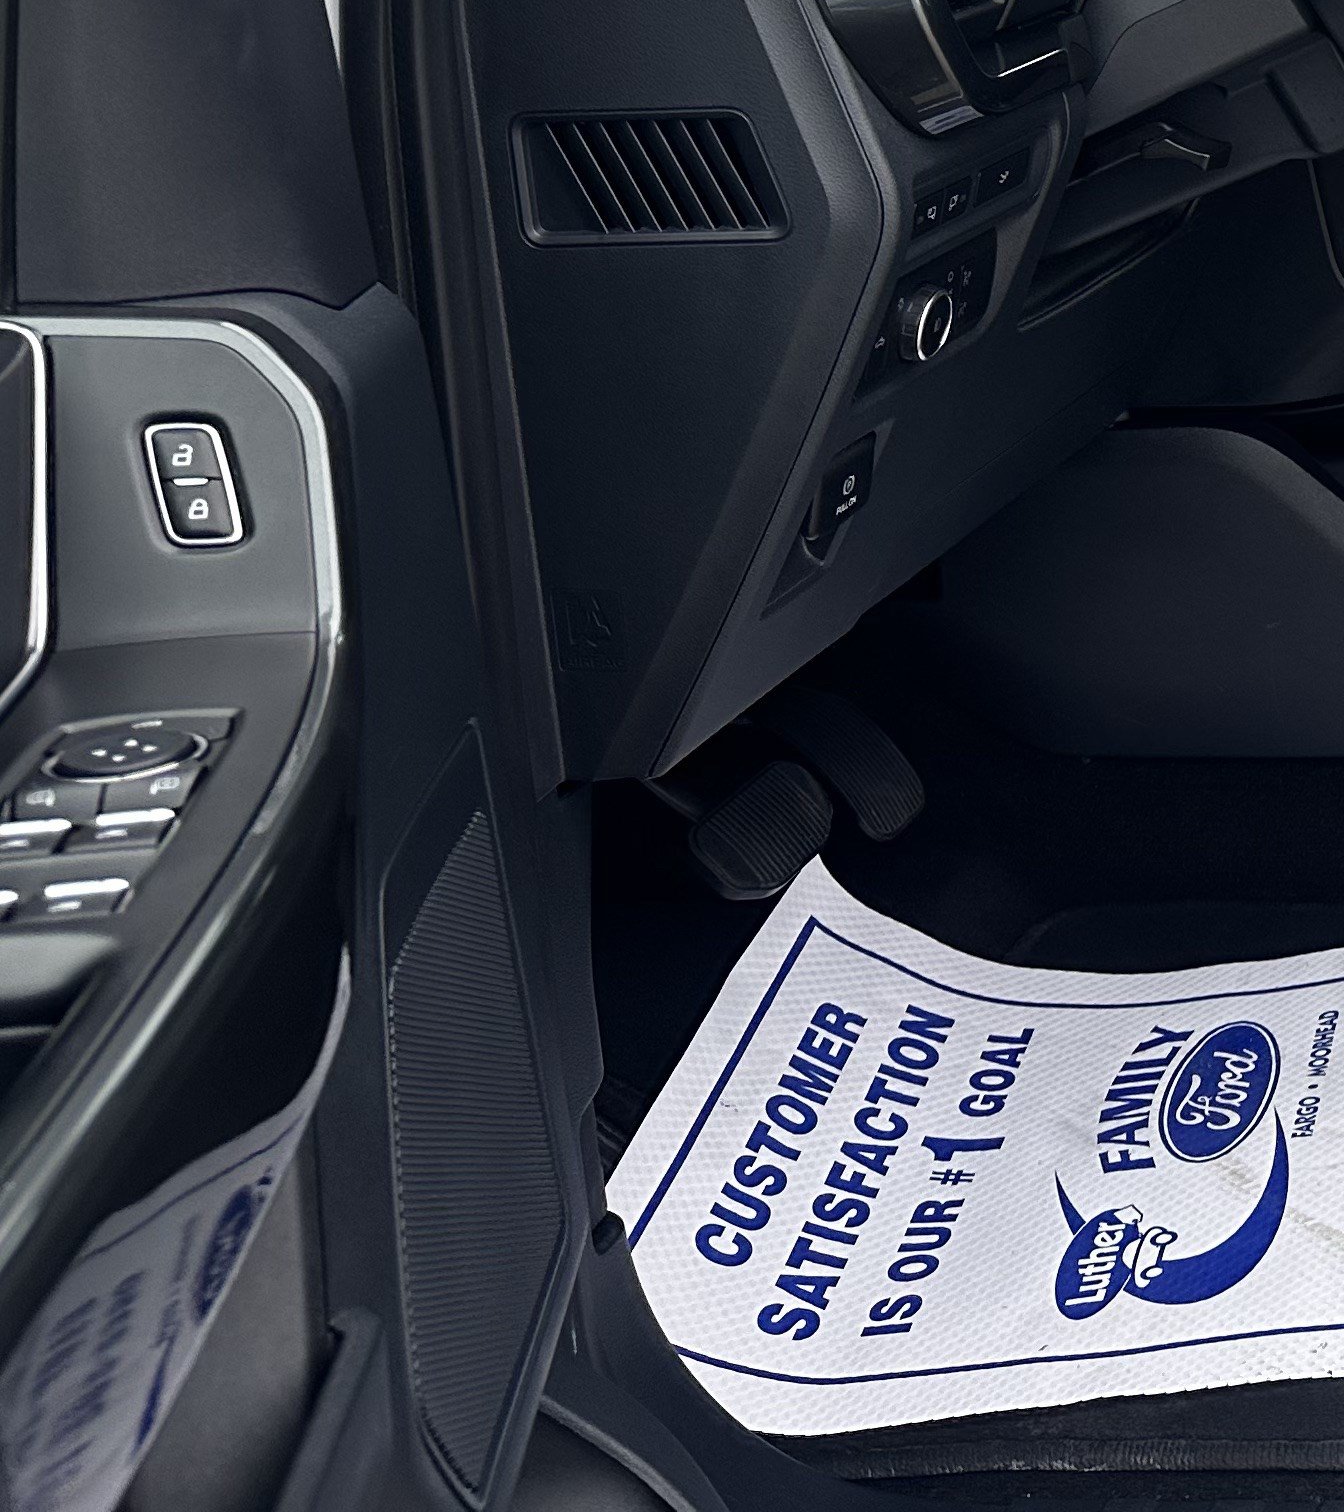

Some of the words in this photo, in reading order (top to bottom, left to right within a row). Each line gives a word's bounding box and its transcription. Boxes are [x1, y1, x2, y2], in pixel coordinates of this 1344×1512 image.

[959, 1028, 1034, 1117] GOAL
[1097, 1026, 1194, 1173] FAMILY
[1175, 1049, 1258, 1130] Ford
[1291, 1096, 1320, 1138] FARGO
[1307, 1010, 1339, 1077] MOORHEAD
[695, 1003, 868, 1266] CUSTOMER
[757, 1004, 955, 1340] SATISFACTION
[888, 1199, 965, 1282] OUR
[1065, 1222, 1126, 1306] Luther
[861, 1295, 922, 1336] IS
